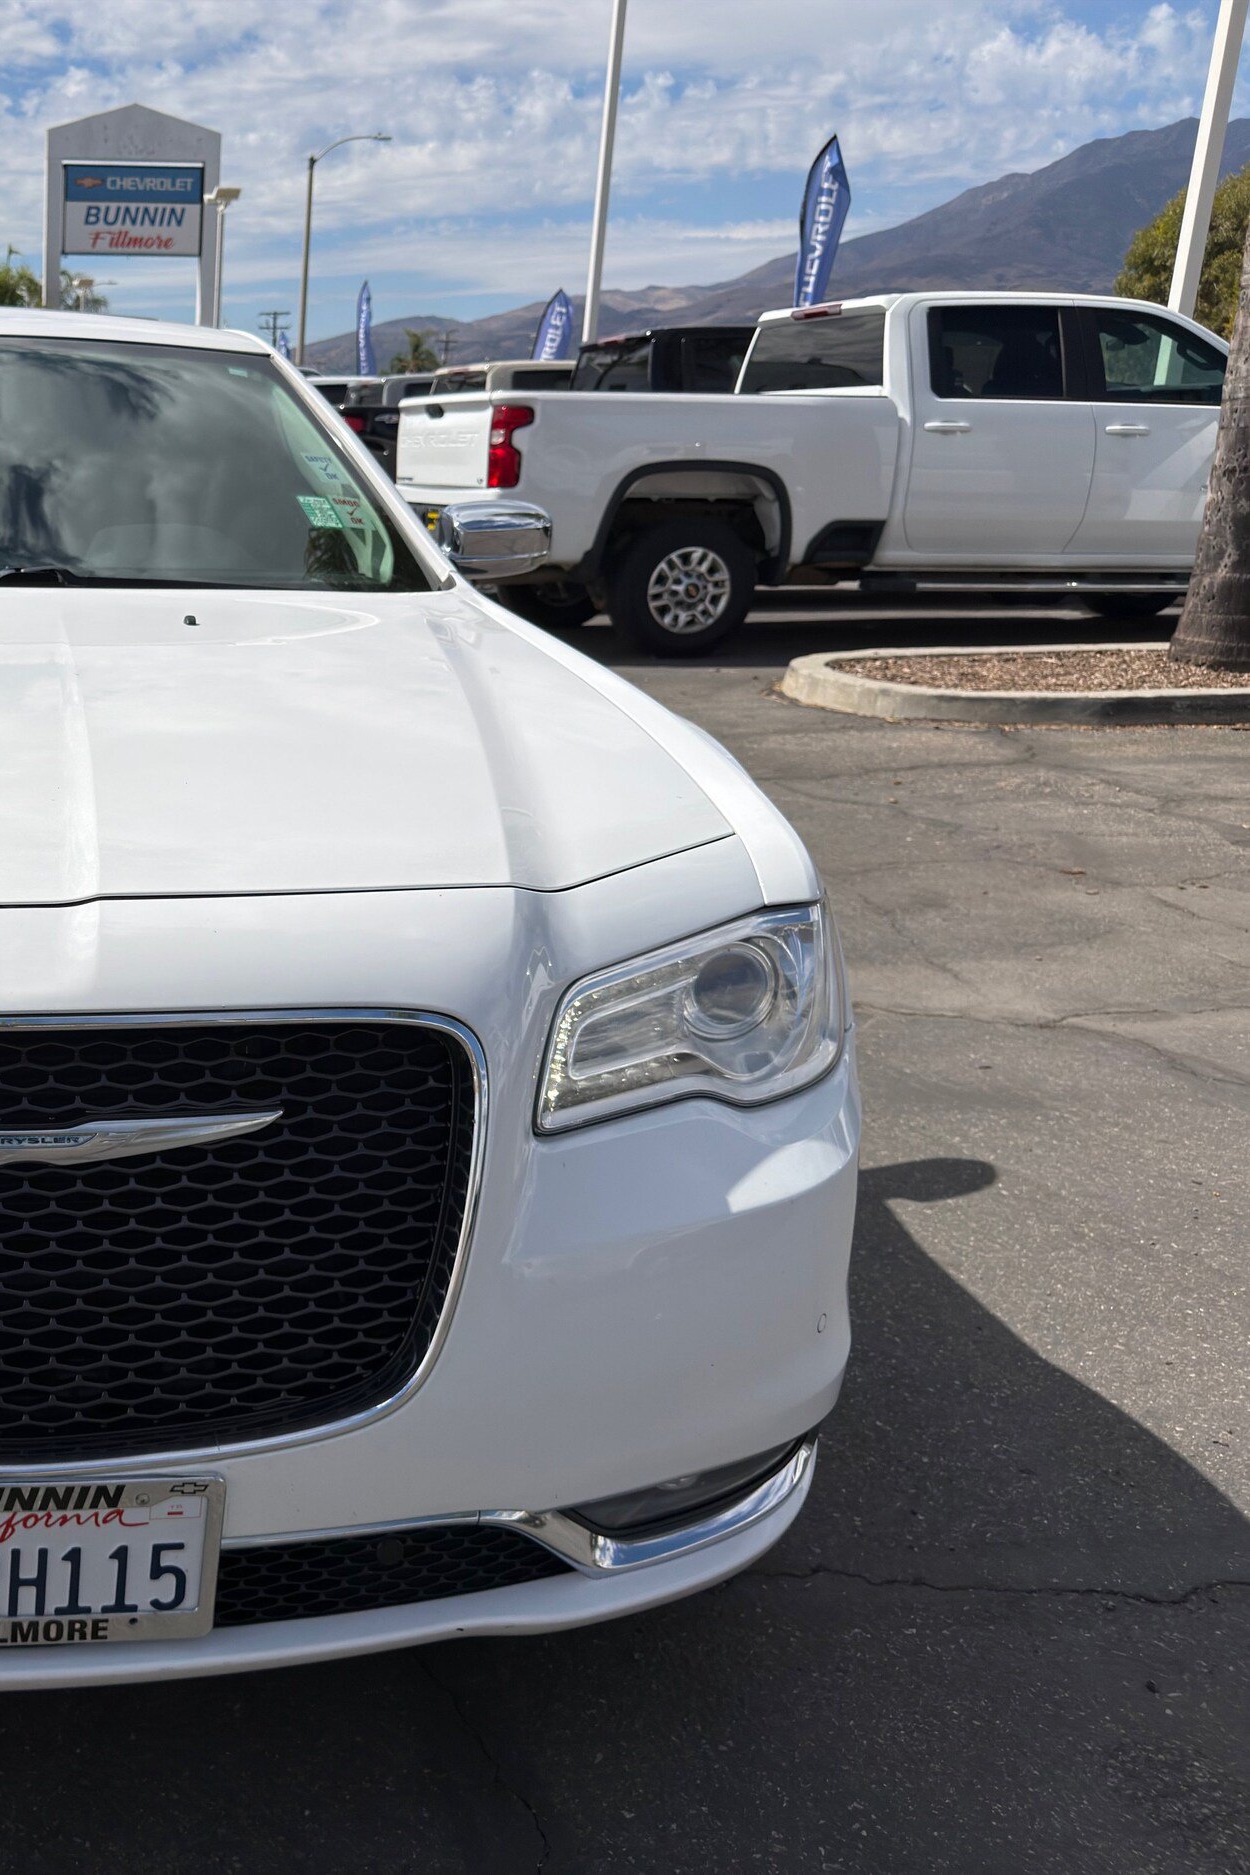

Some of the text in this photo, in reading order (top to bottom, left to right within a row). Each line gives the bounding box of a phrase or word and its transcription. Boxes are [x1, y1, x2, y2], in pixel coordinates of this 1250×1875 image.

[106, 176, 193, 192] CHEVROLET
[84, 205, 186, 227] BUNNIN
[90, 230, 174, 249] Fillmore
